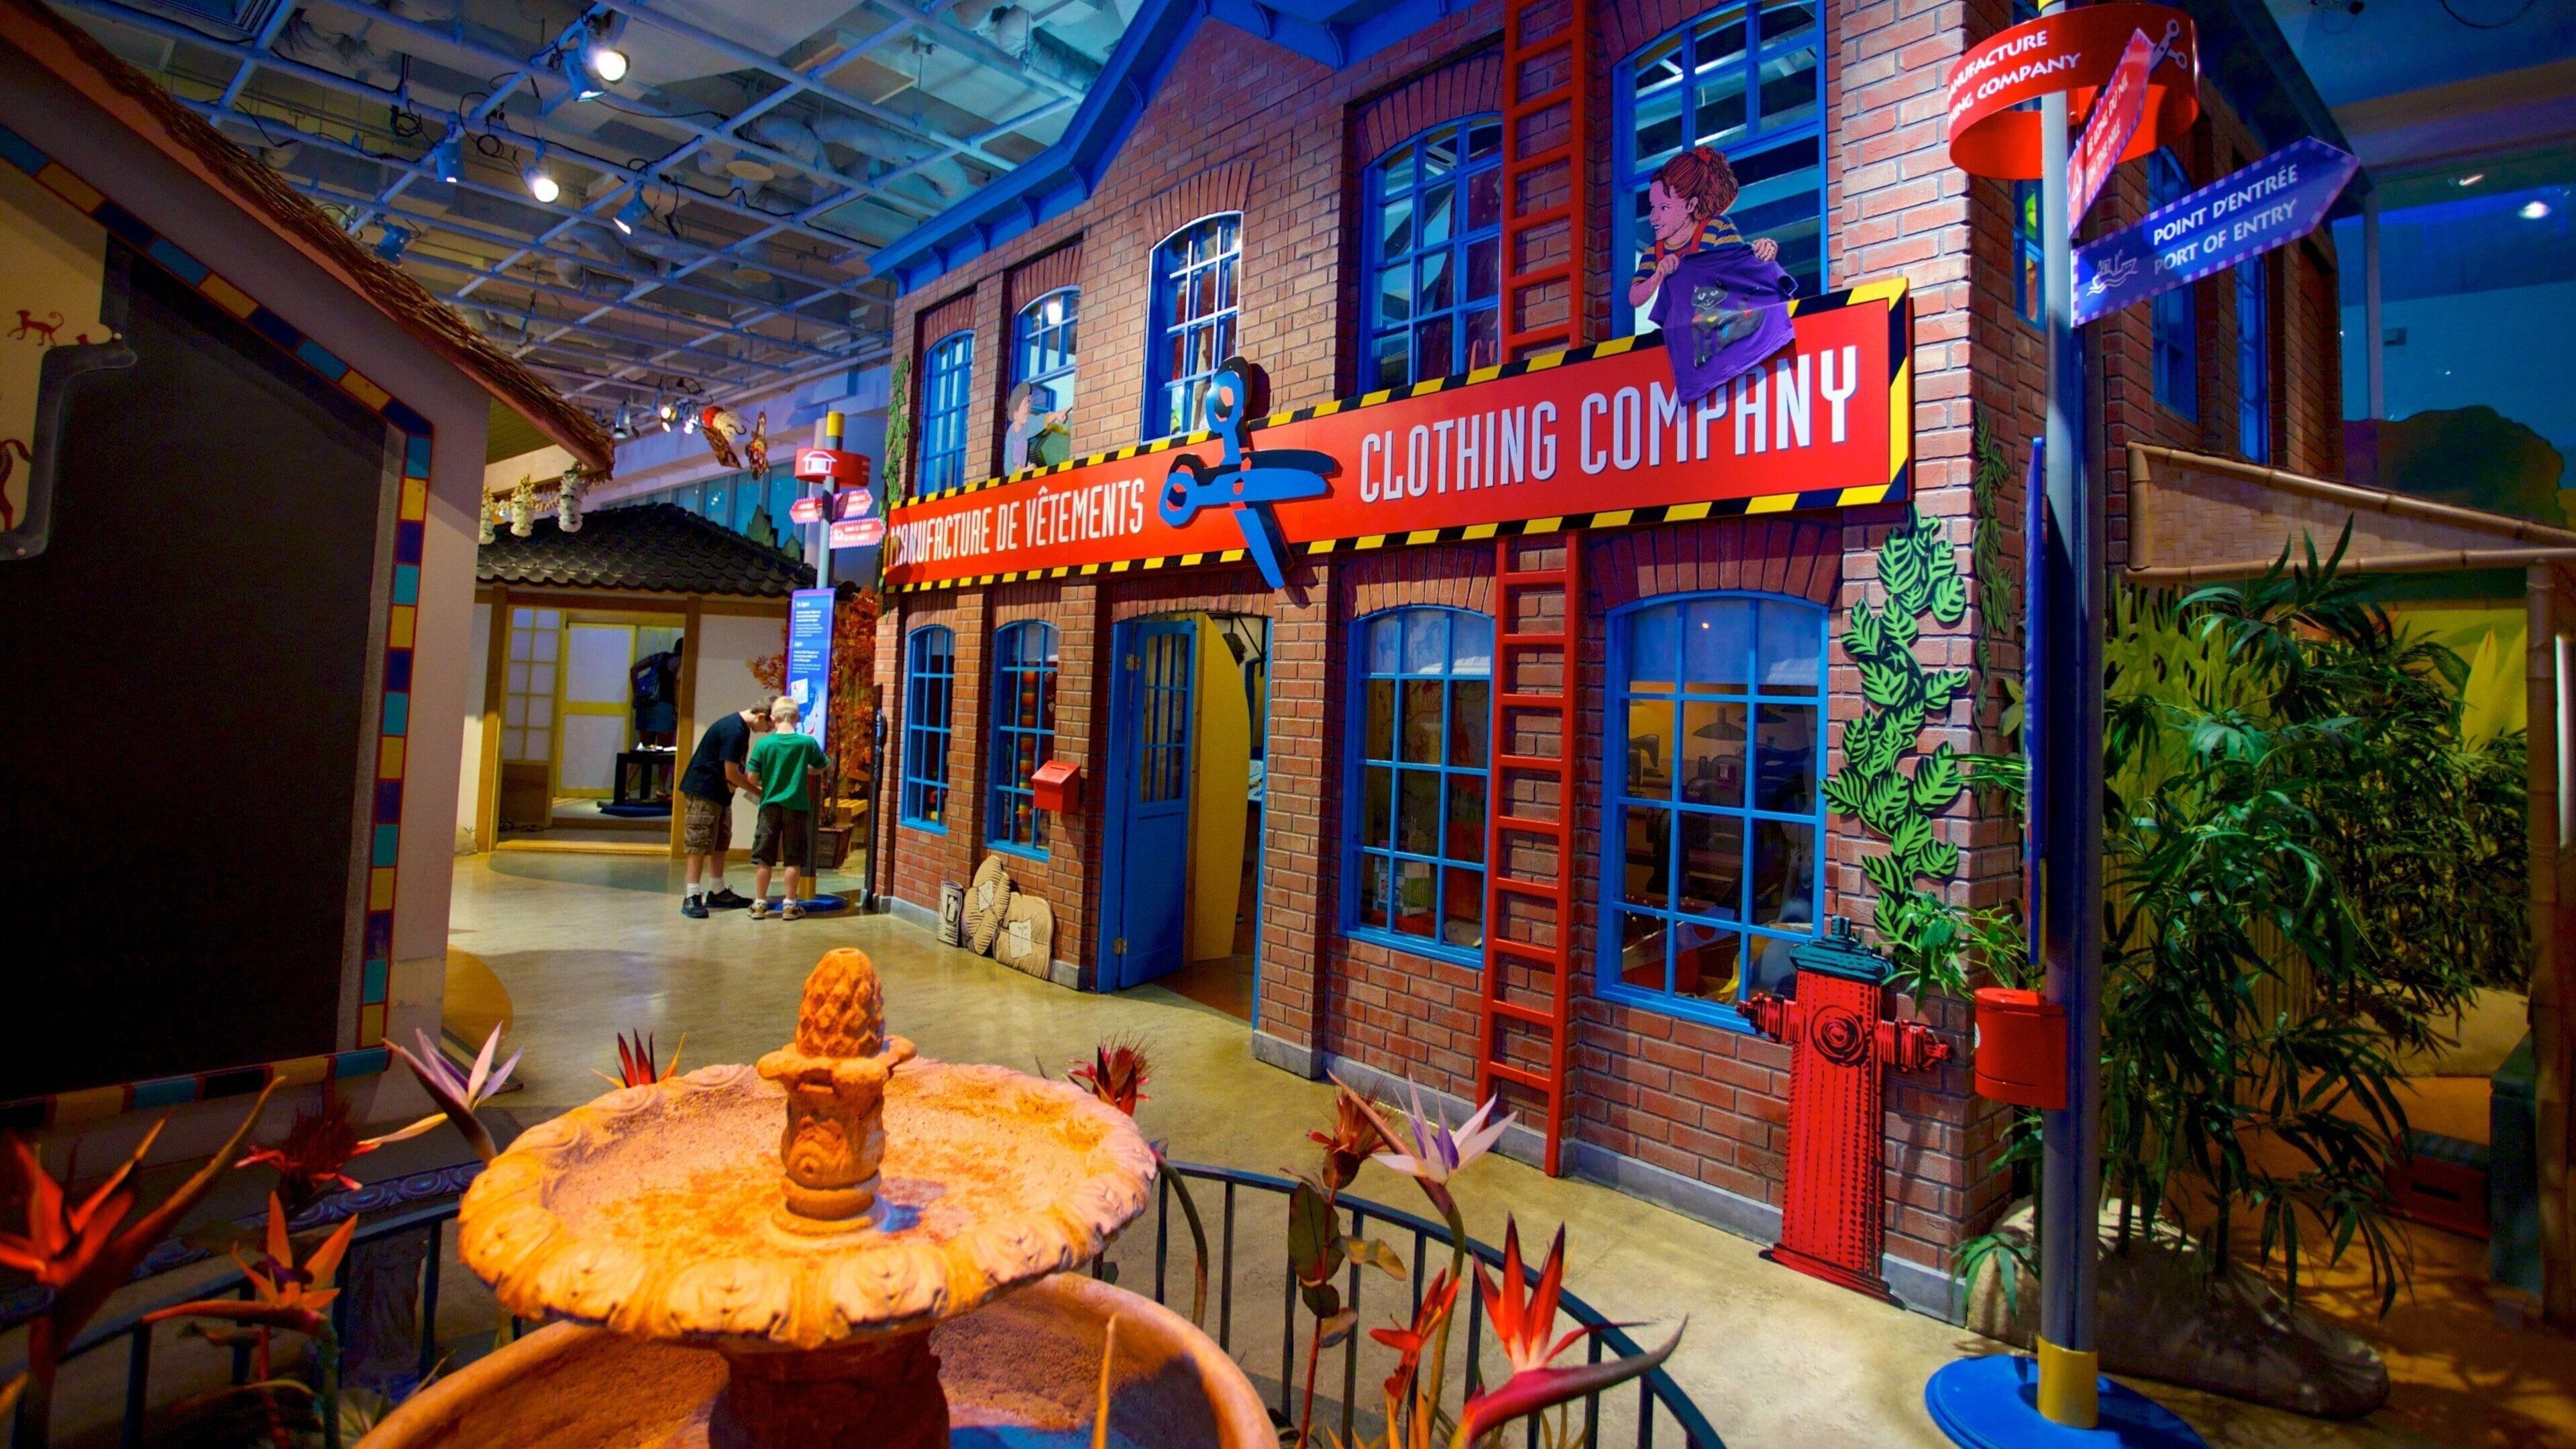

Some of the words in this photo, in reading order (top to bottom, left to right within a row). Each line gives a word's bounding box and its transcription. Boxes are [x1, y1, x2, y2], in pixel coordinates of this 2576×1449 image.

[1977, 52, 2081, 99] COMPANY
[2108, 90, 2117, 117] DU
[2153, 207, 2207, 246] POINT
[2212, 164, 2297, 219] D'ENTRÉE
[2154, 242, 2198, 274] PORT
[2203, 229, 2226, 254] OF
[2234, 197, 2297, 241] ENTRY
[1360, 400, 1558, 503] CLOTHING
[1580, 345, 1858, 476] COMPANY
[889, 507, 993, 566] MANUFACTURE
[996, 500, 1020, 552] DE
[1026, 478, 1144, 548] VÊTEMENTS
